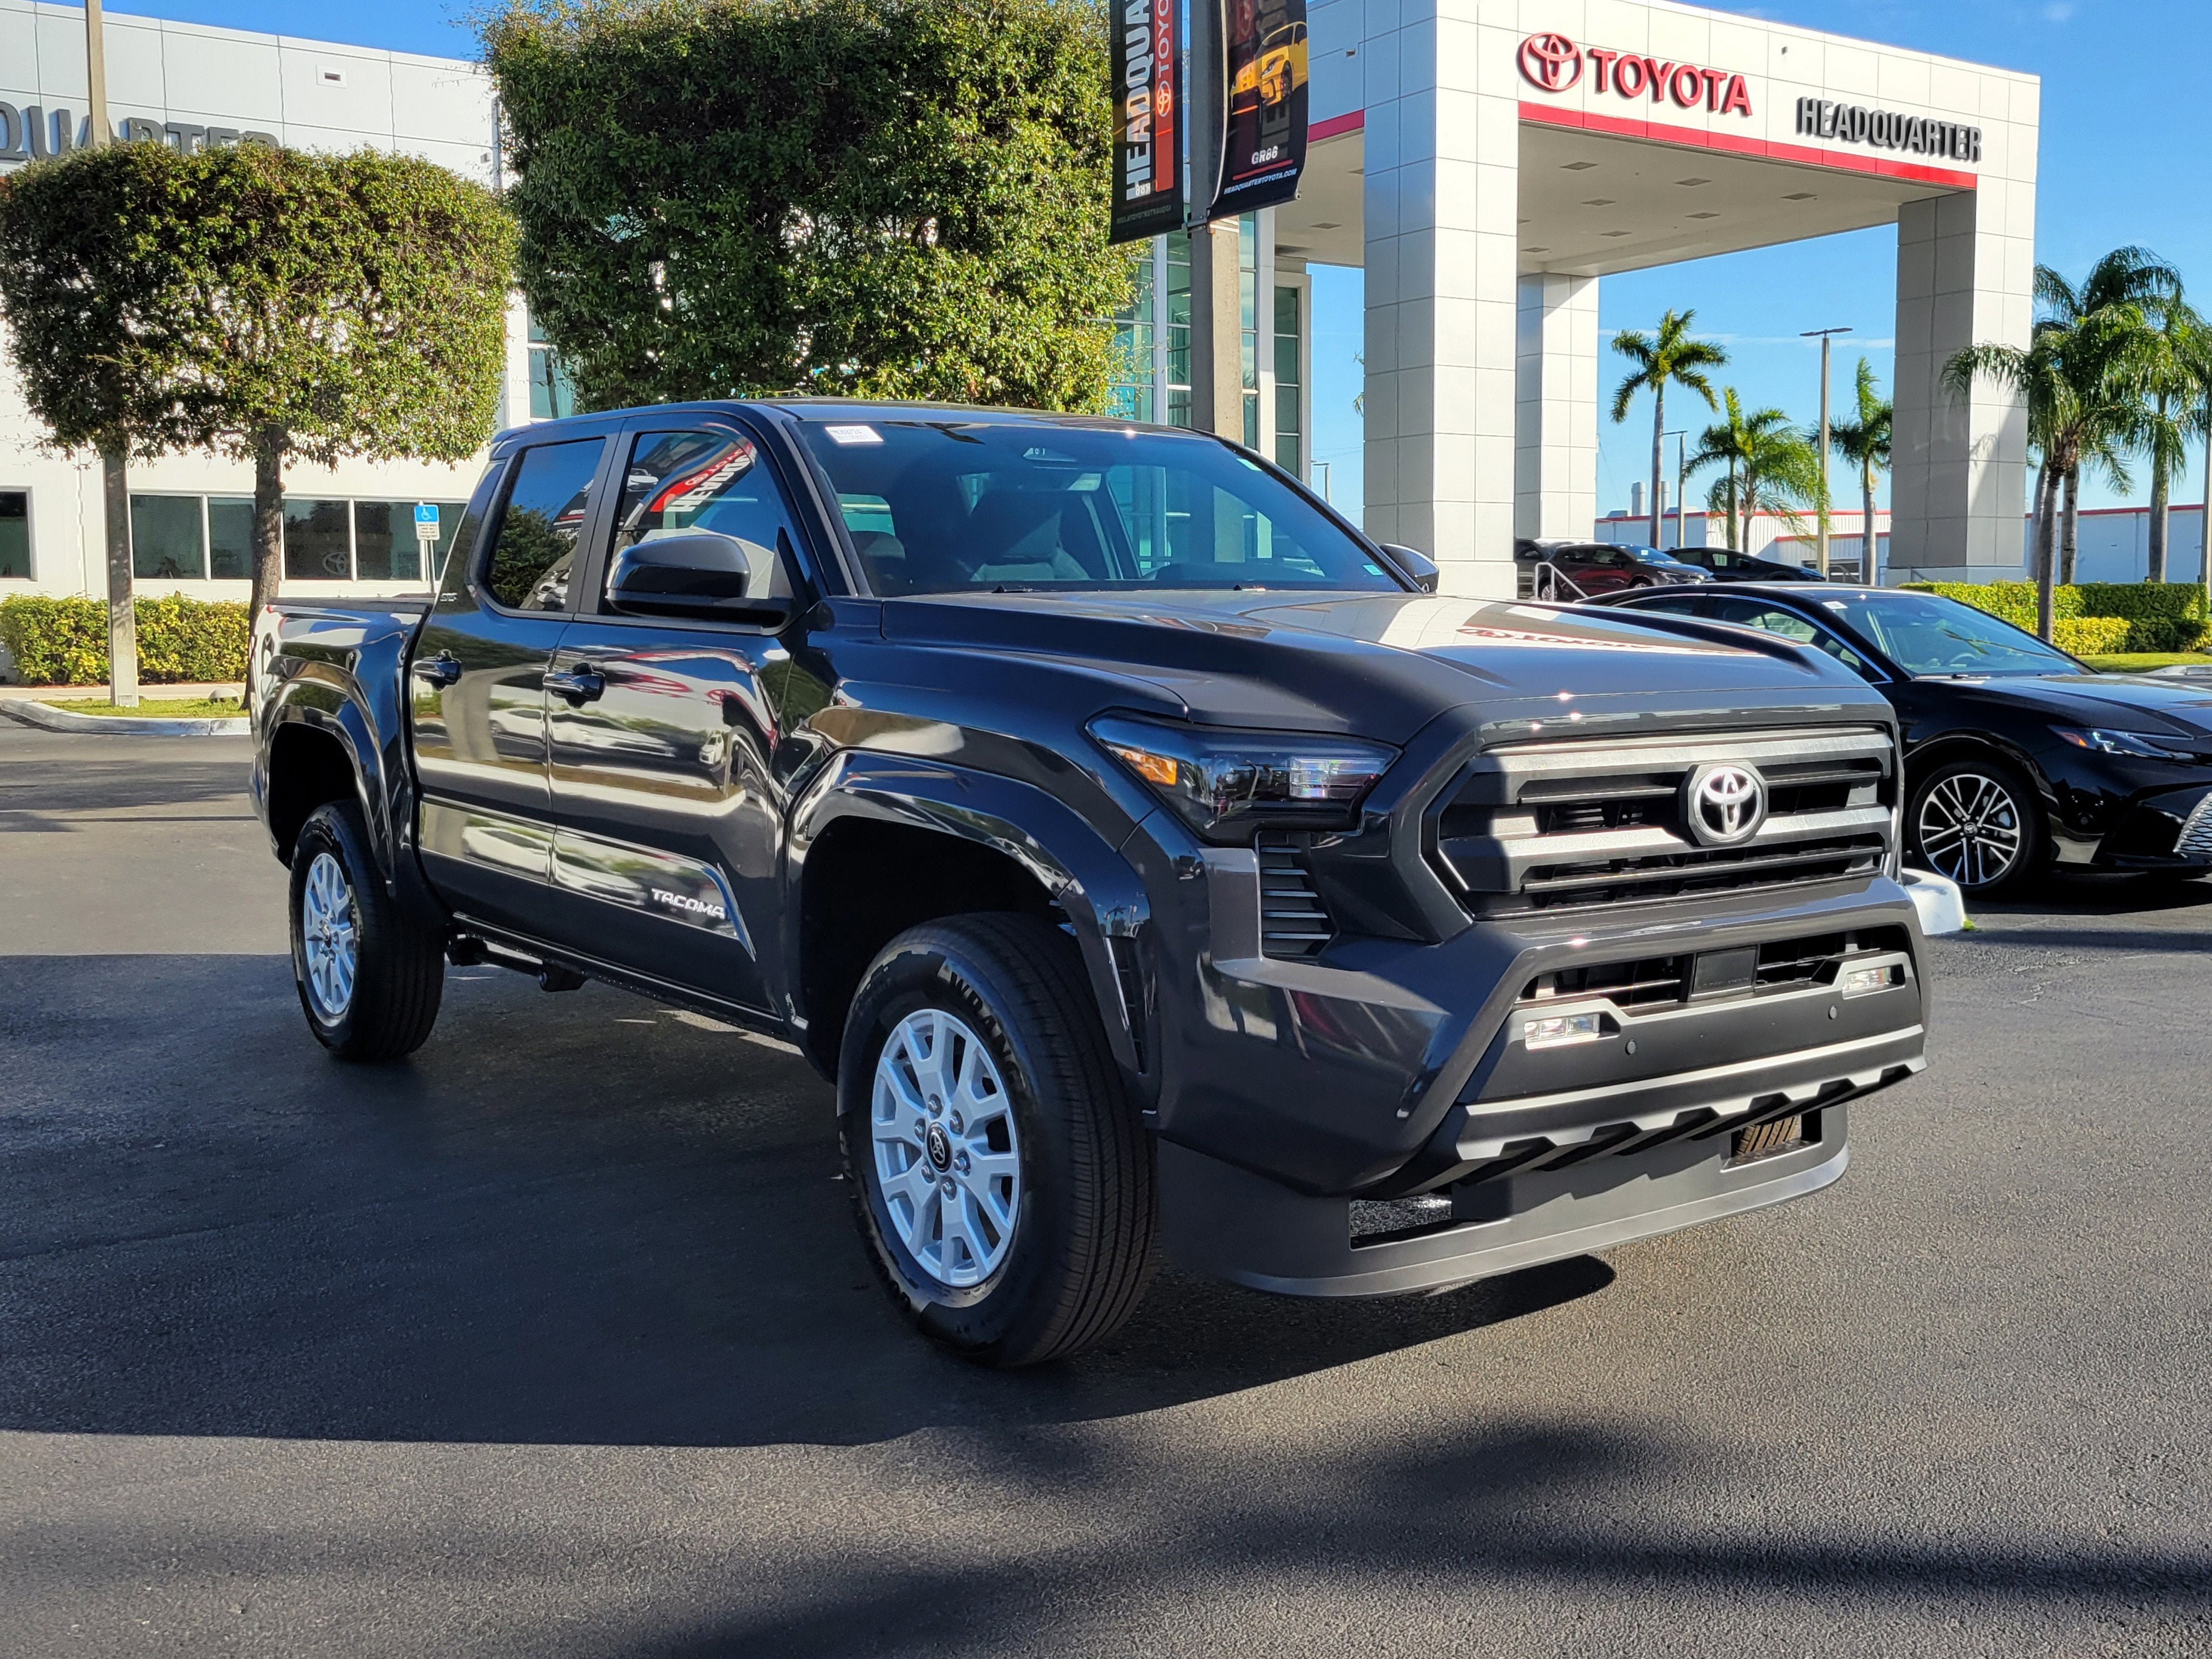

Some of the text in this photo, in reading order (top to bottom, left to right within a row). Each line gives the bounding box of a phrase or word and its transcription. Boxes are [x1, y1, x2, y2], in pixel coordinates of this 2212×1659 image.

[1587, 48, 1752, 116] TOYOTA
[1796, 97, 1982, 162] HEADQUARTER
[1251, 145, 1278, 165] GR86
[1223, 168, 1297, 195] HEADQUARTERTOYOTA.COM
[651, 888, 726, 919] TACOMA
